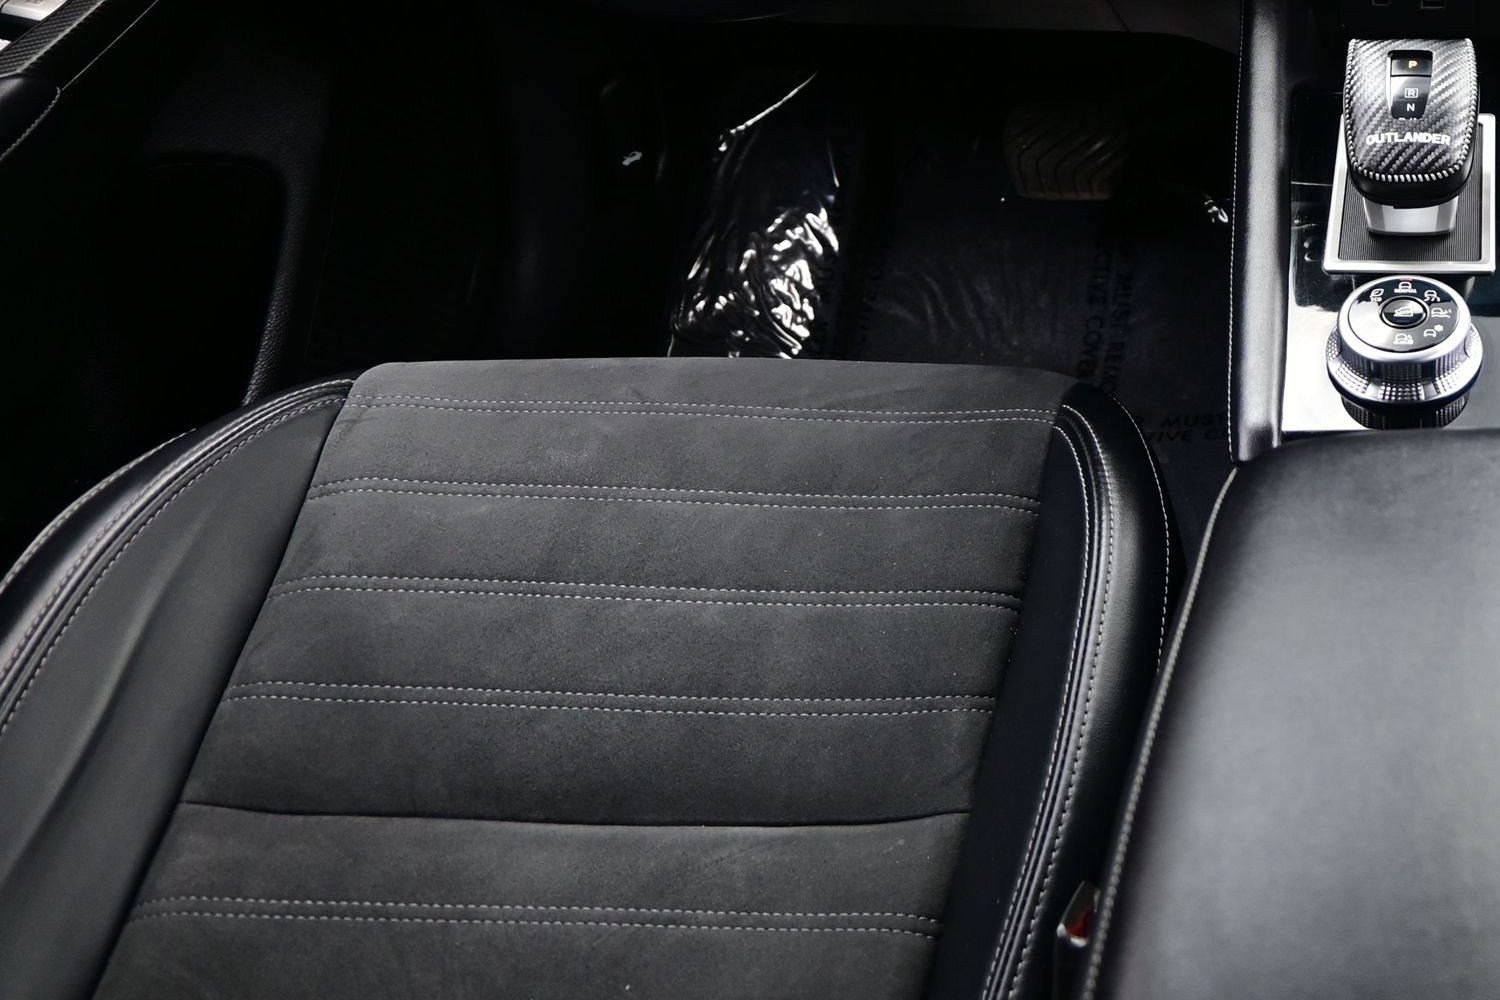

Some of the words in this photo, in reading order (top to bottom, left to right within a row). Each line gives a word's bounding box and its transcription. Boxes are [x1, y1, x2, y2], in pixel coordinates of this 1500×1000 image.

[1408, 60, 1418, 69] P
[1406, 103, 1415, 112] N
[1366, 132, 1451, 146] OUTLANDER
